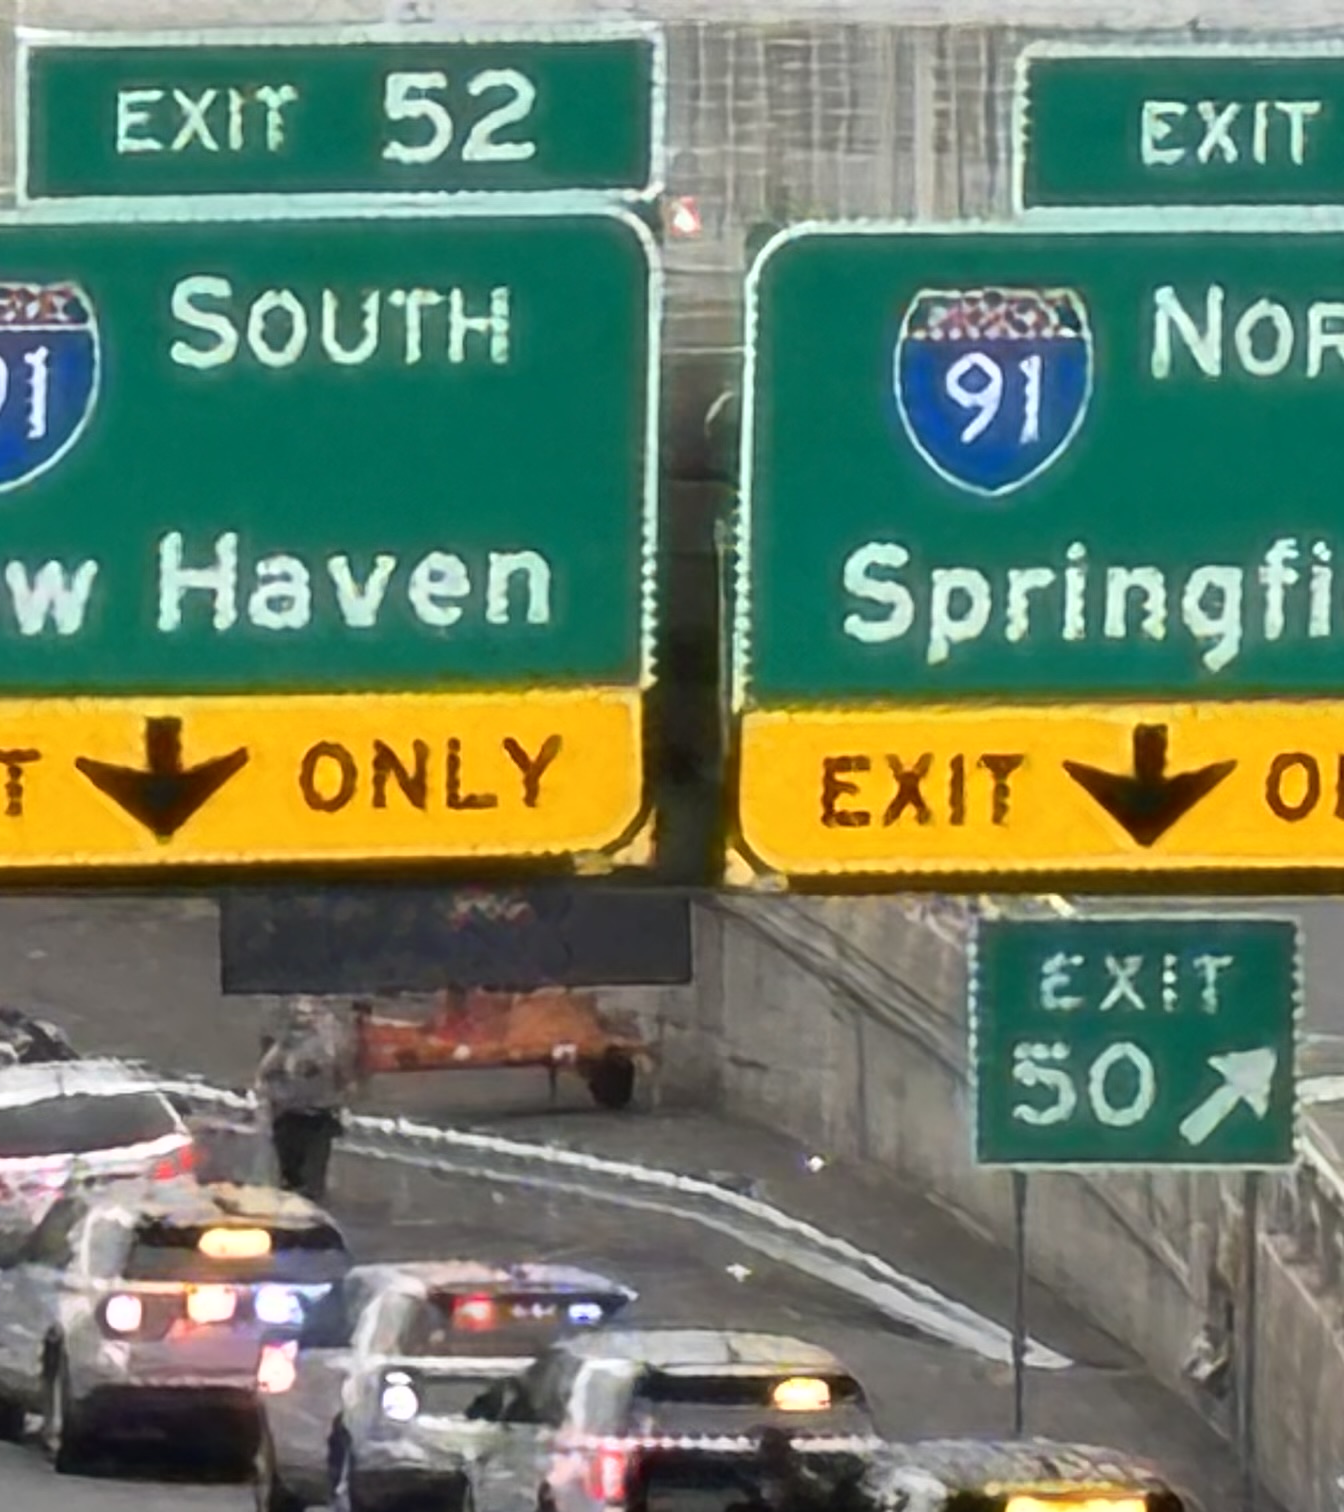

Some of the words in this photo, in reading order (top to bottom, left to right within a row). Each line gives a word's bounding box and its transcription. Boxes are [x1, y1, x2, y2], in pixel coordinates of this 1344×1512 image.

[116, 84, 299, 153] EXIT
[382, 68, 536, 164] 52
[1141, 99, 1322, 166] EXIT
[170, 276, 511, 369] SOUTH
[945, 351, 1042, 443] 91
[157, 531, 552, 632] Haven
[299, 735, 561, 813] ONLY
[821, 754, 1025, 827] EXIT
[1041, 952, 1234, 1014] EXIT
[1011, 1042, 1155, 1127] 50
